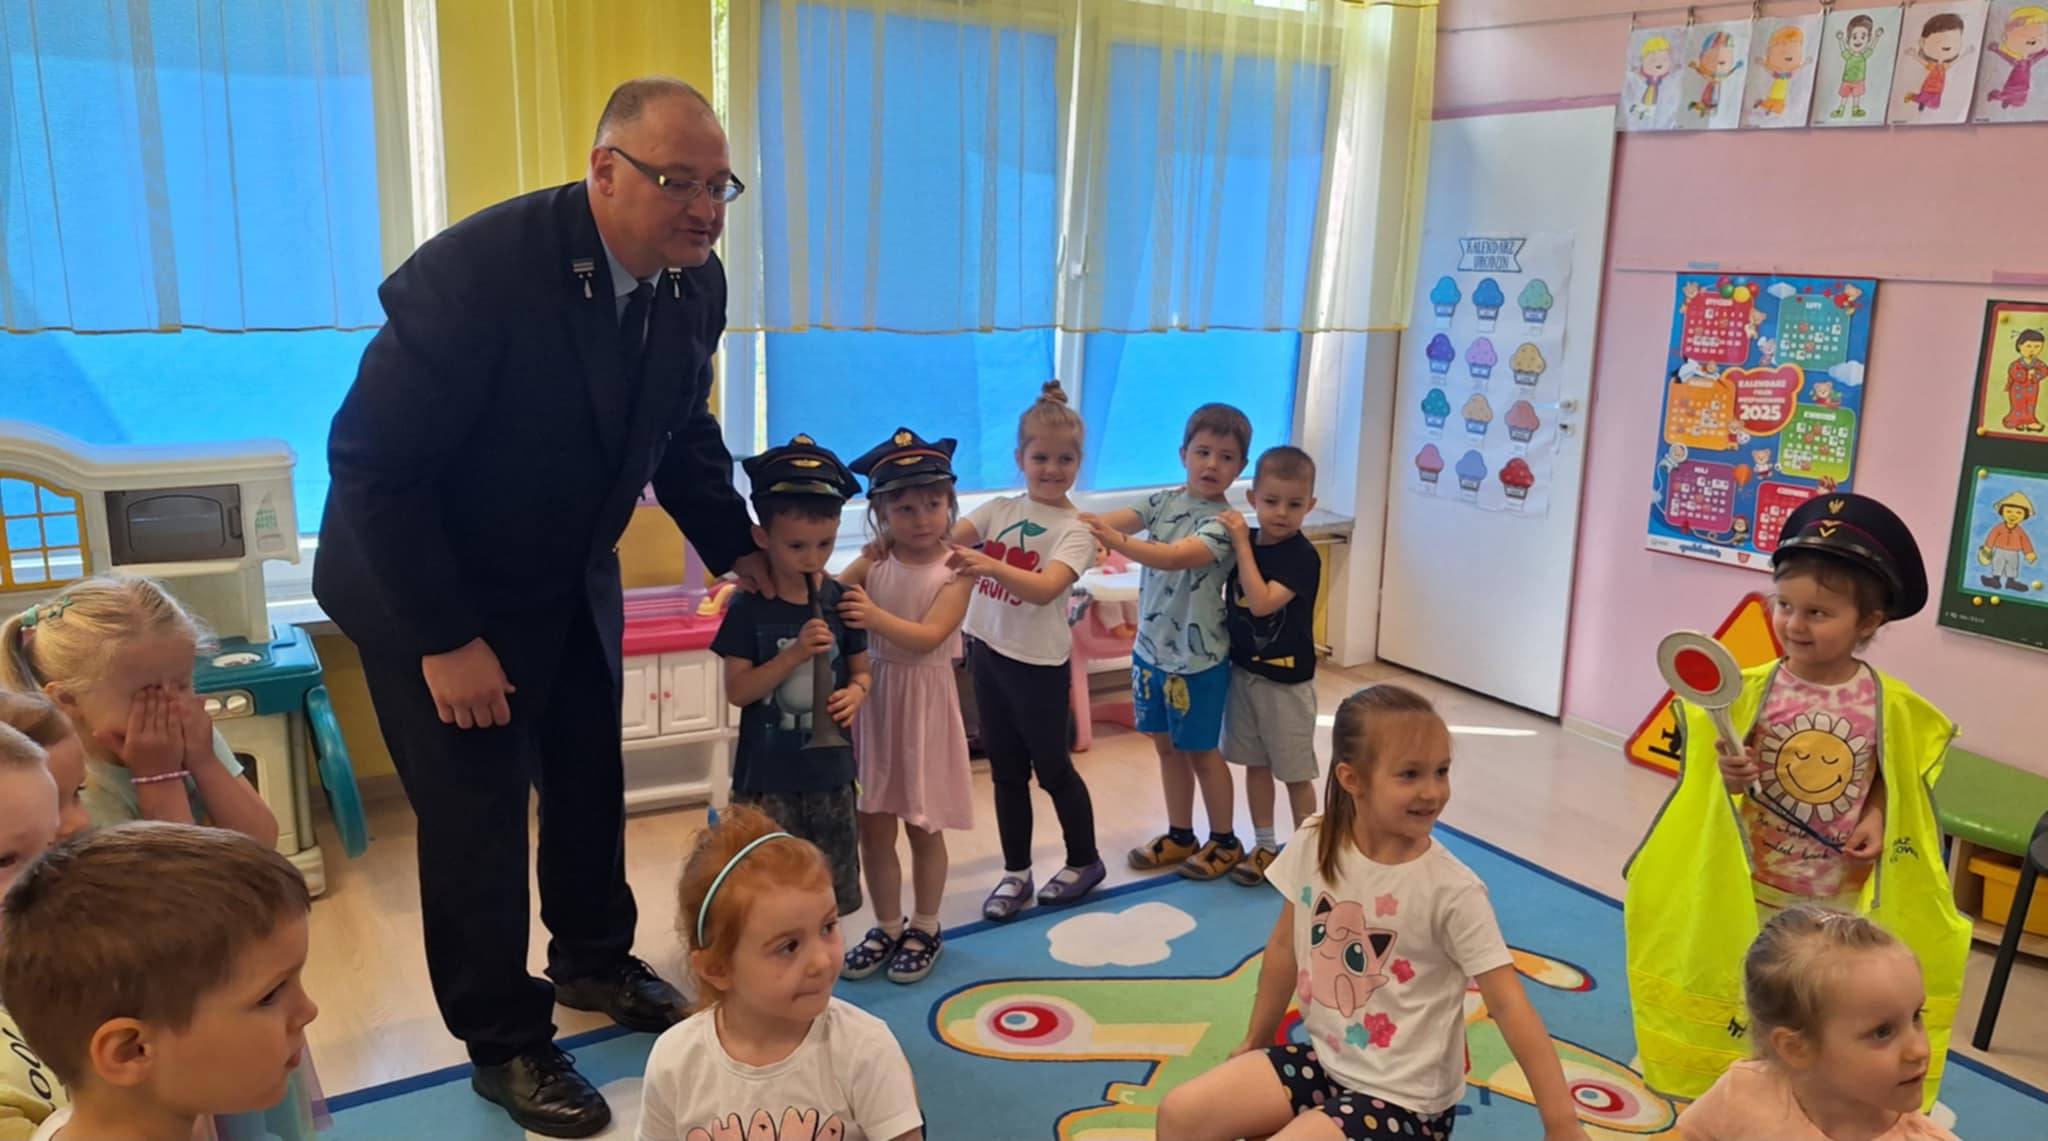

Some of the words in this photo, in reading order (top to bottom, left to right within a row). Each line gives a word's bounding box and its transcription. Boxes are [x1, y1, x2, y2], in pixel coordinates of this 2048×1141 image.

[1466, 240, 1514, 255] KALENDARZ
[1473, 255, 1509, 268] URODZIN
[1739, 404, 1782, 421] 2025
